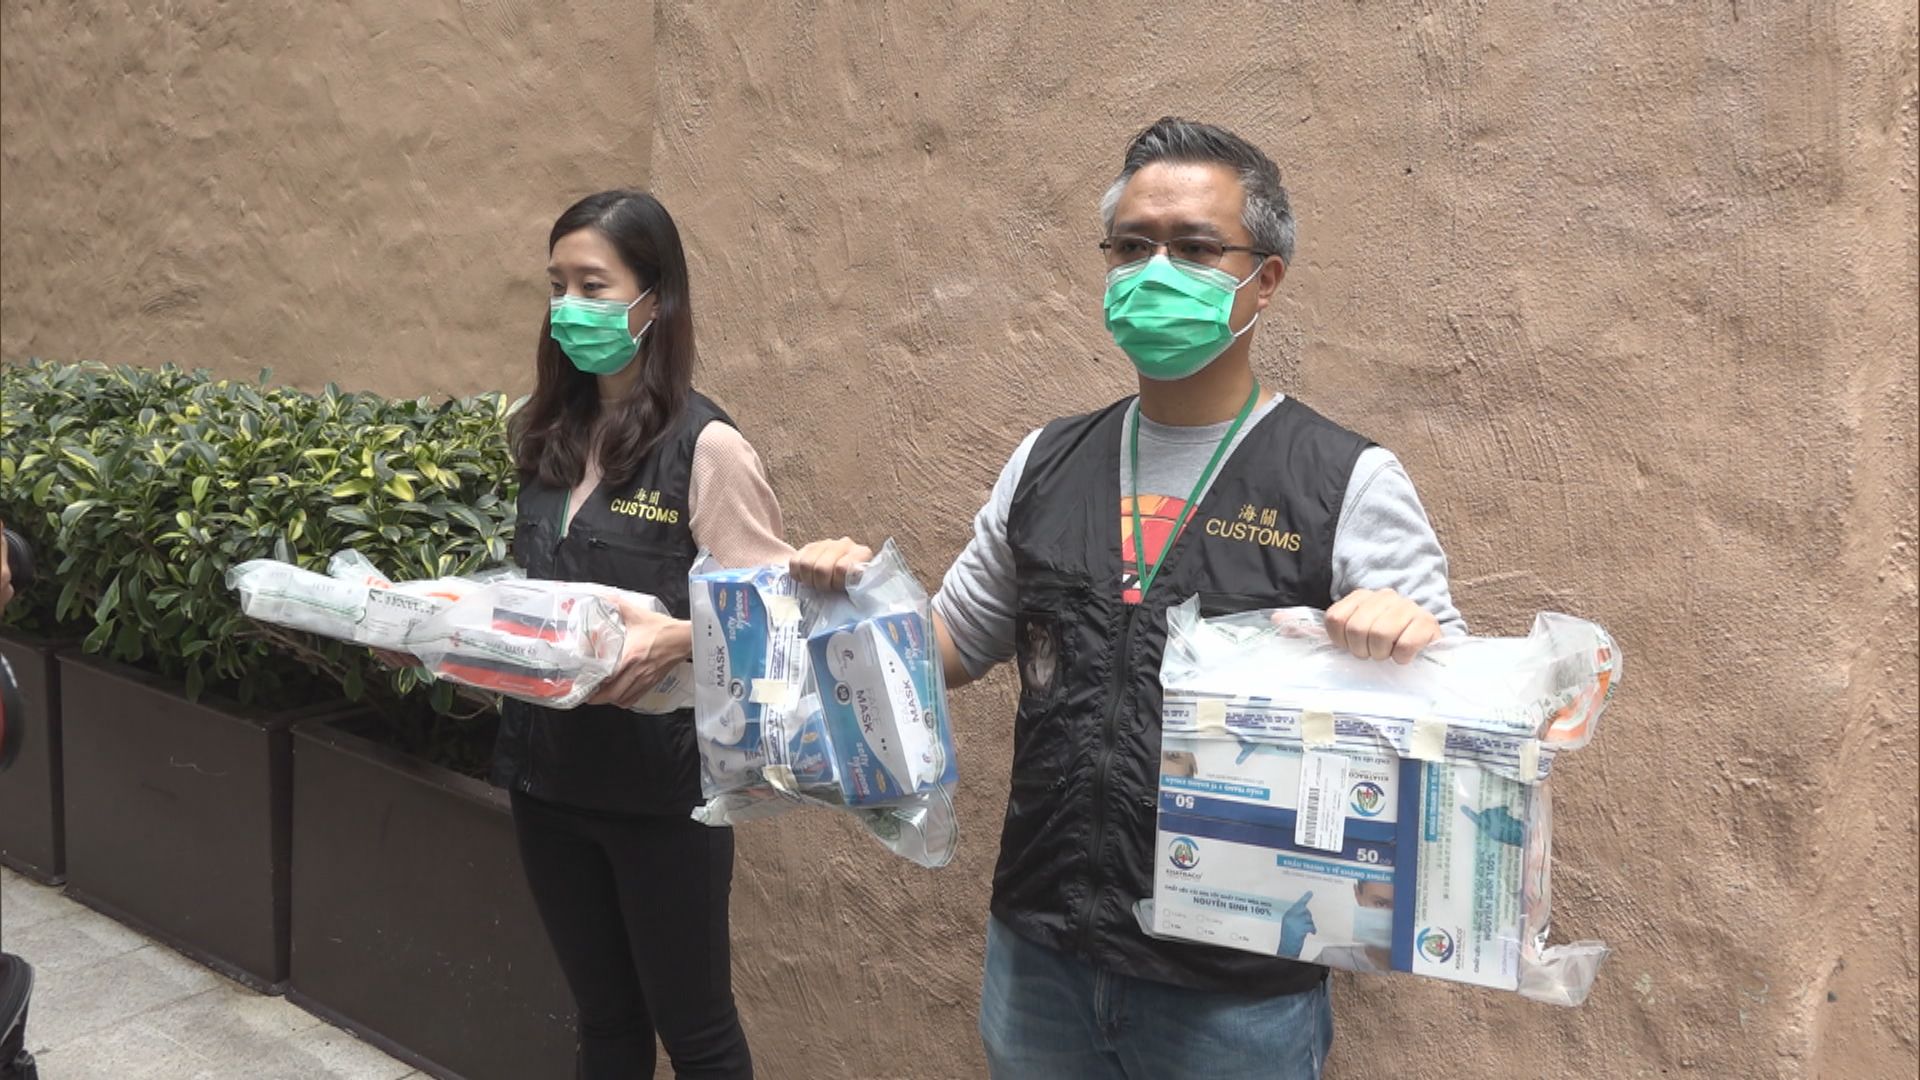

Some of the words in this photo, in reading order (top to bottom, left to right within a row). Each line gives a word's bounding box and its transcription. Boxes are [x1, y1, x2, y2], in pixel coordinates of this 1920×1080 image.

[610, 498, 679, 524] CUSTOMS
[1238, 503, 1278, 528] 海關
[1205, 518, 1302, 551] CUSTOMS
[716, 646, 725, 687] MASK
[856, 689, 874, 734] MASK
[903, 680, 920, 723] MASK
[1176, 793, 1194, 809] 50
[1357, 847, 1379, 864] 50
[1228, 901, 1248, 913] SINH
[1250, 905, 1272, 917] 100%
